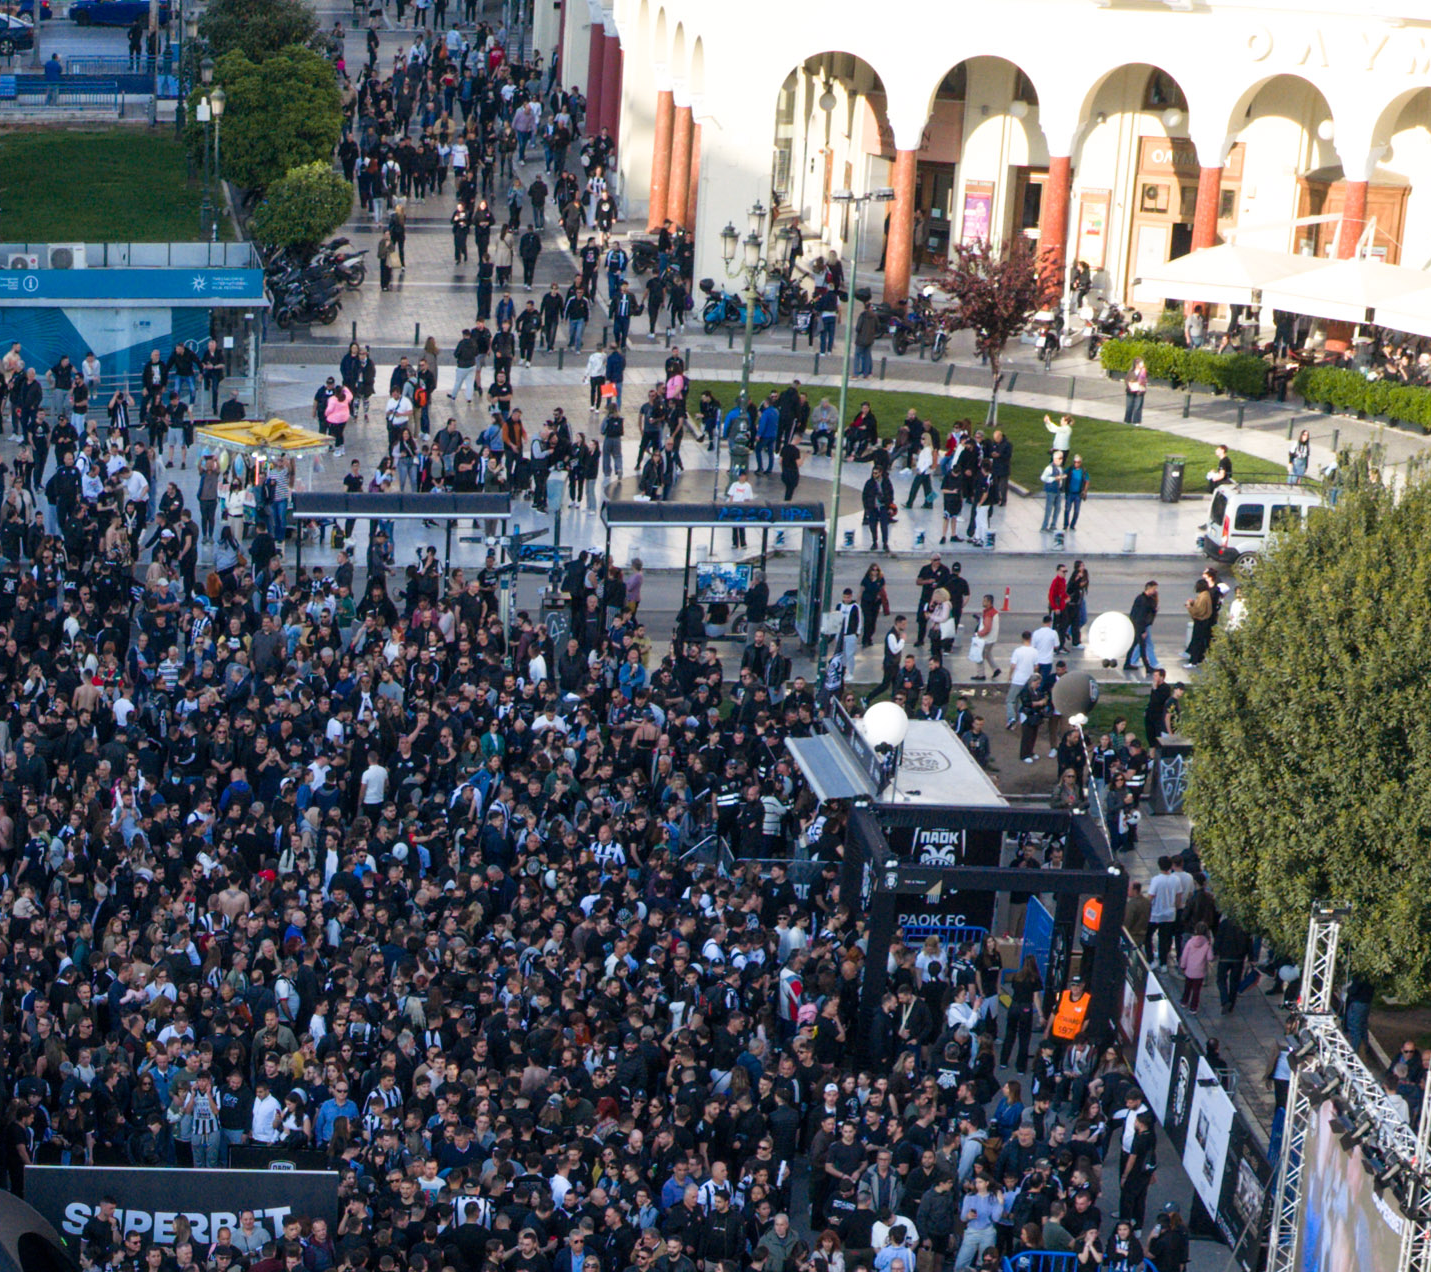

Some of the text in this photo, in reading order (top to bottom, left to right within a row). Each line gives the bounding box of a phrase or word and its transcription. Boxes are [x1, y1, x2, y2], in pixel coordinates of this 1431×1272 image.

[920, 830, 960, 843] ΠΑΟΚ
[899, 914, 968, 927] PAOK FC
